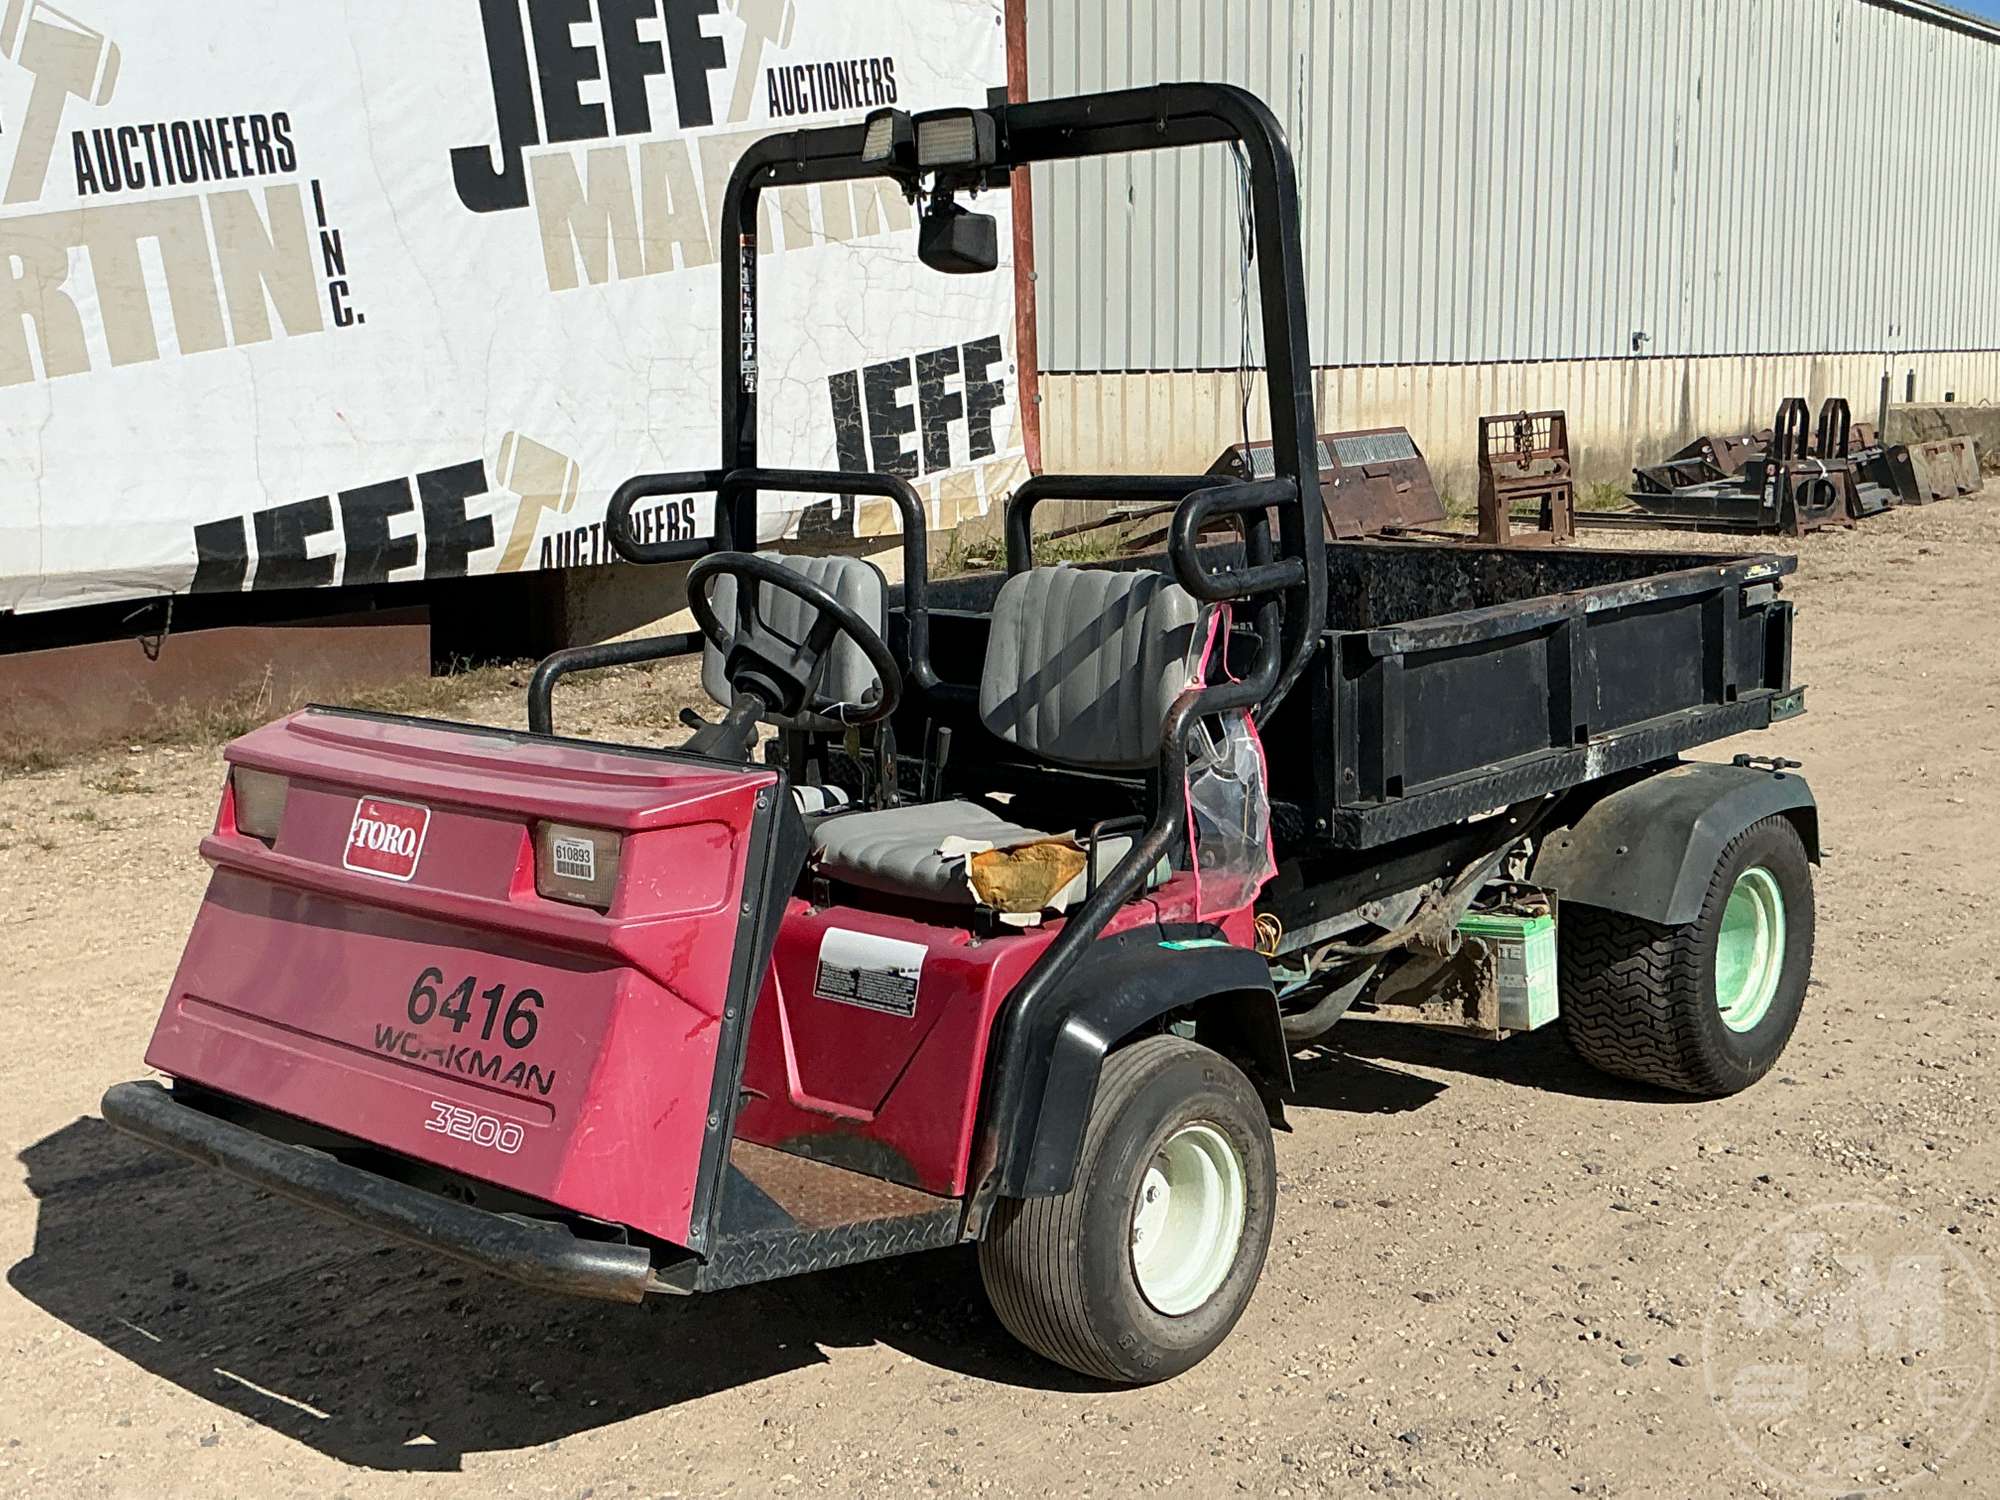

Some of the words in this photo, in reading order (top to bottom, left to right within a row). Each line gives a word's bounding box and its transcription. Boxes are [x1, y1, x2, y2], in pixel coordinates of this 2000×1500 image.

[449, 0, 727, 213] JEFF
[766, 56, 897, 118] AUCTIONEERS
[71, 112, 297, 196] AUCTIONEERS
[539, 497, 695, 570] AUCTINEERS
[353, 817, 416, 857] TORO
[556, 845, 590, 864] 610893
[407, 966, 545, 1050] 6416
[424, 1100, 525, 1154] 3200
